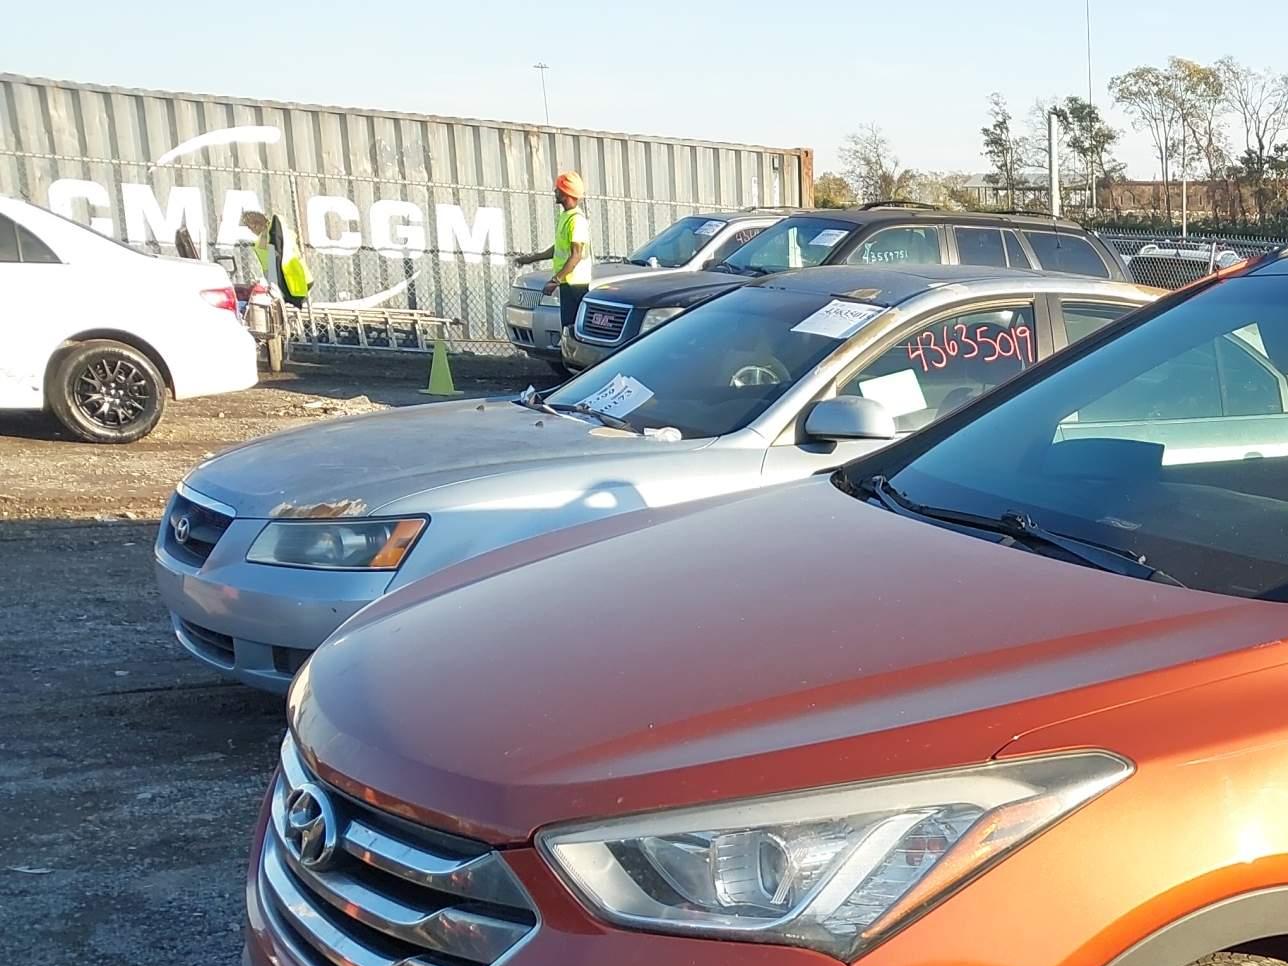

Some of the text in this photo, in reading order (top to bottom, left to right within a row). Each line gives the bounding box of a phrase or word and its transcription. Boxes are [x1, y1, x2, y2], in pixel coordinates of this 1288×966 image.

[47, 178, 507, 265] CMA CGM
[908, 324, 1033, 373] 43635019
